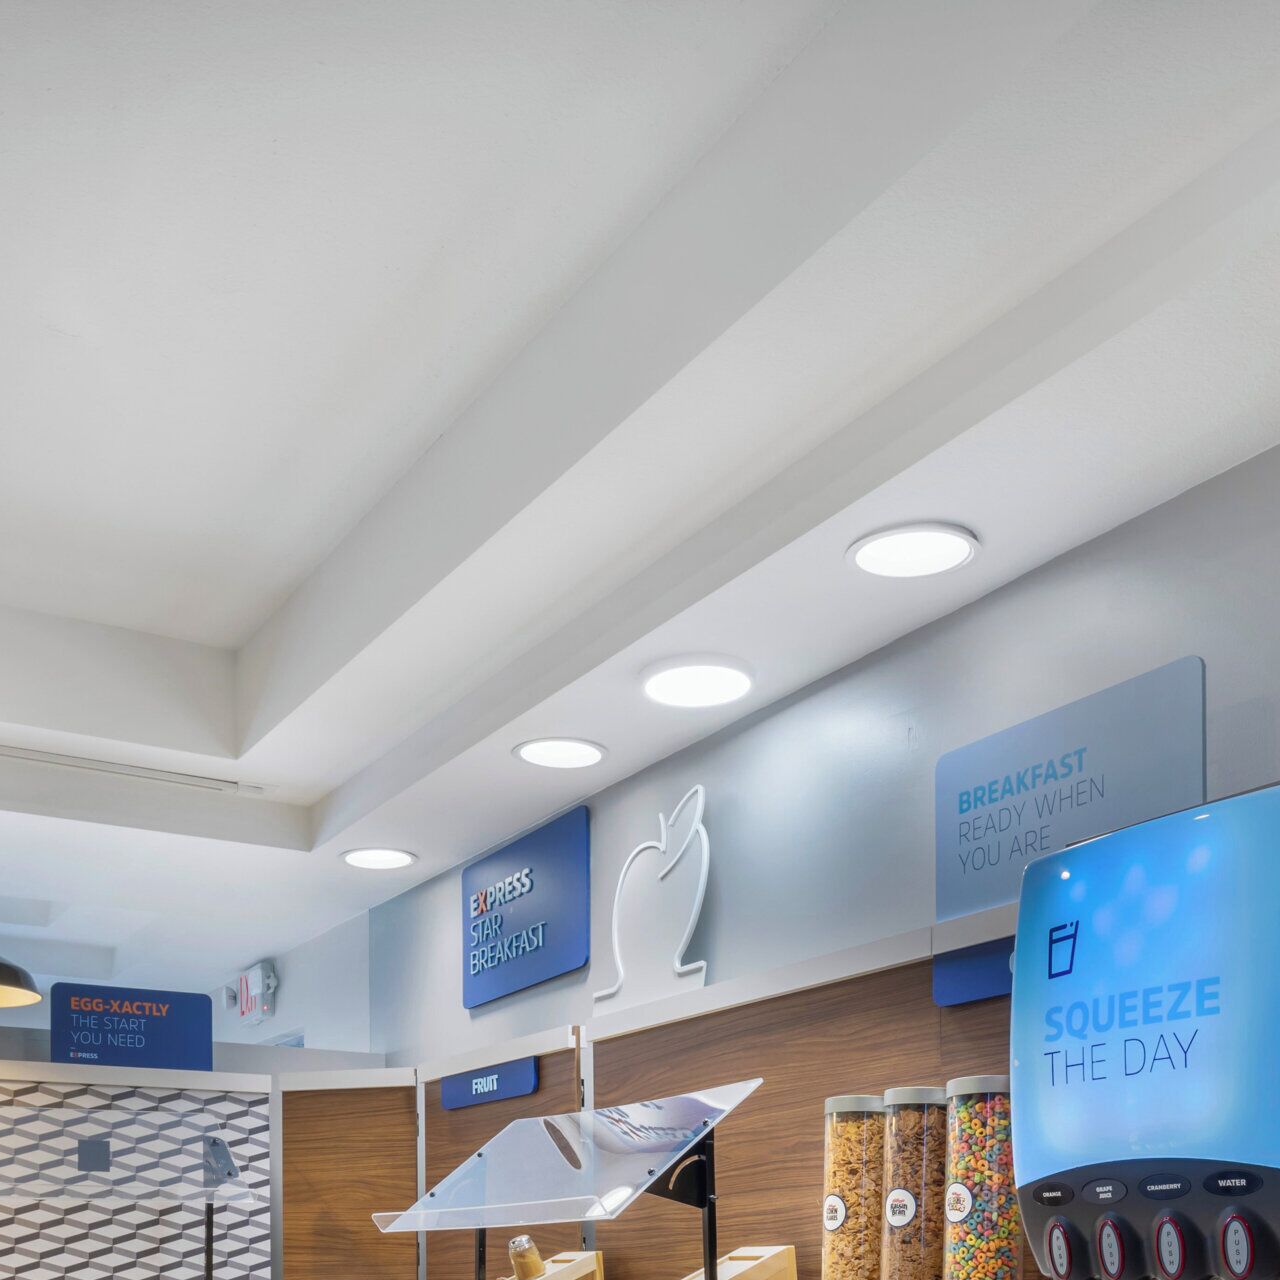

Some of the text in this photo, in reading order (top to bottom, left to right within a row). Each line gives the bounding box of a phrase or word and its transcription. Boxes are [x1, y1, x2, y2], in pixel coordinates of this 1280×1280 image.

[958, 747, 1087, 815] BREAKFAST
[959, 774, 1106, 846] READY WHEN
[958, 825, 1051, 875] YOU ARE
[470, 868, 532, 918] EXPRESS
[470, 913, 502, 946] STAR
[470, 921, 546, 975] BREAKFAST
[69, 996, 170, 1017] EGG-XACTLY
[70, 1014, 147, 1031] THE START
[1043, 976, 1221, 1041] SQUEEZE
[70, 1031, 145, 1048] YOU NEED
[1043, 1028, 1199, 1087] THE DAY
[472, 1074, 499, 1096] FRUIT
[1146, 1183, 1181, 1191] CRANBERRY
[1218, 1178, 1247, 1187] WATER
[1056, 1235, 1064, 1268] PUSH
[1106, 1233, 1115, 1266] PUSH
[1166, 1231, 1175, 1266] PUSH
[1233, 1229, 1242, 1266] PUSH
